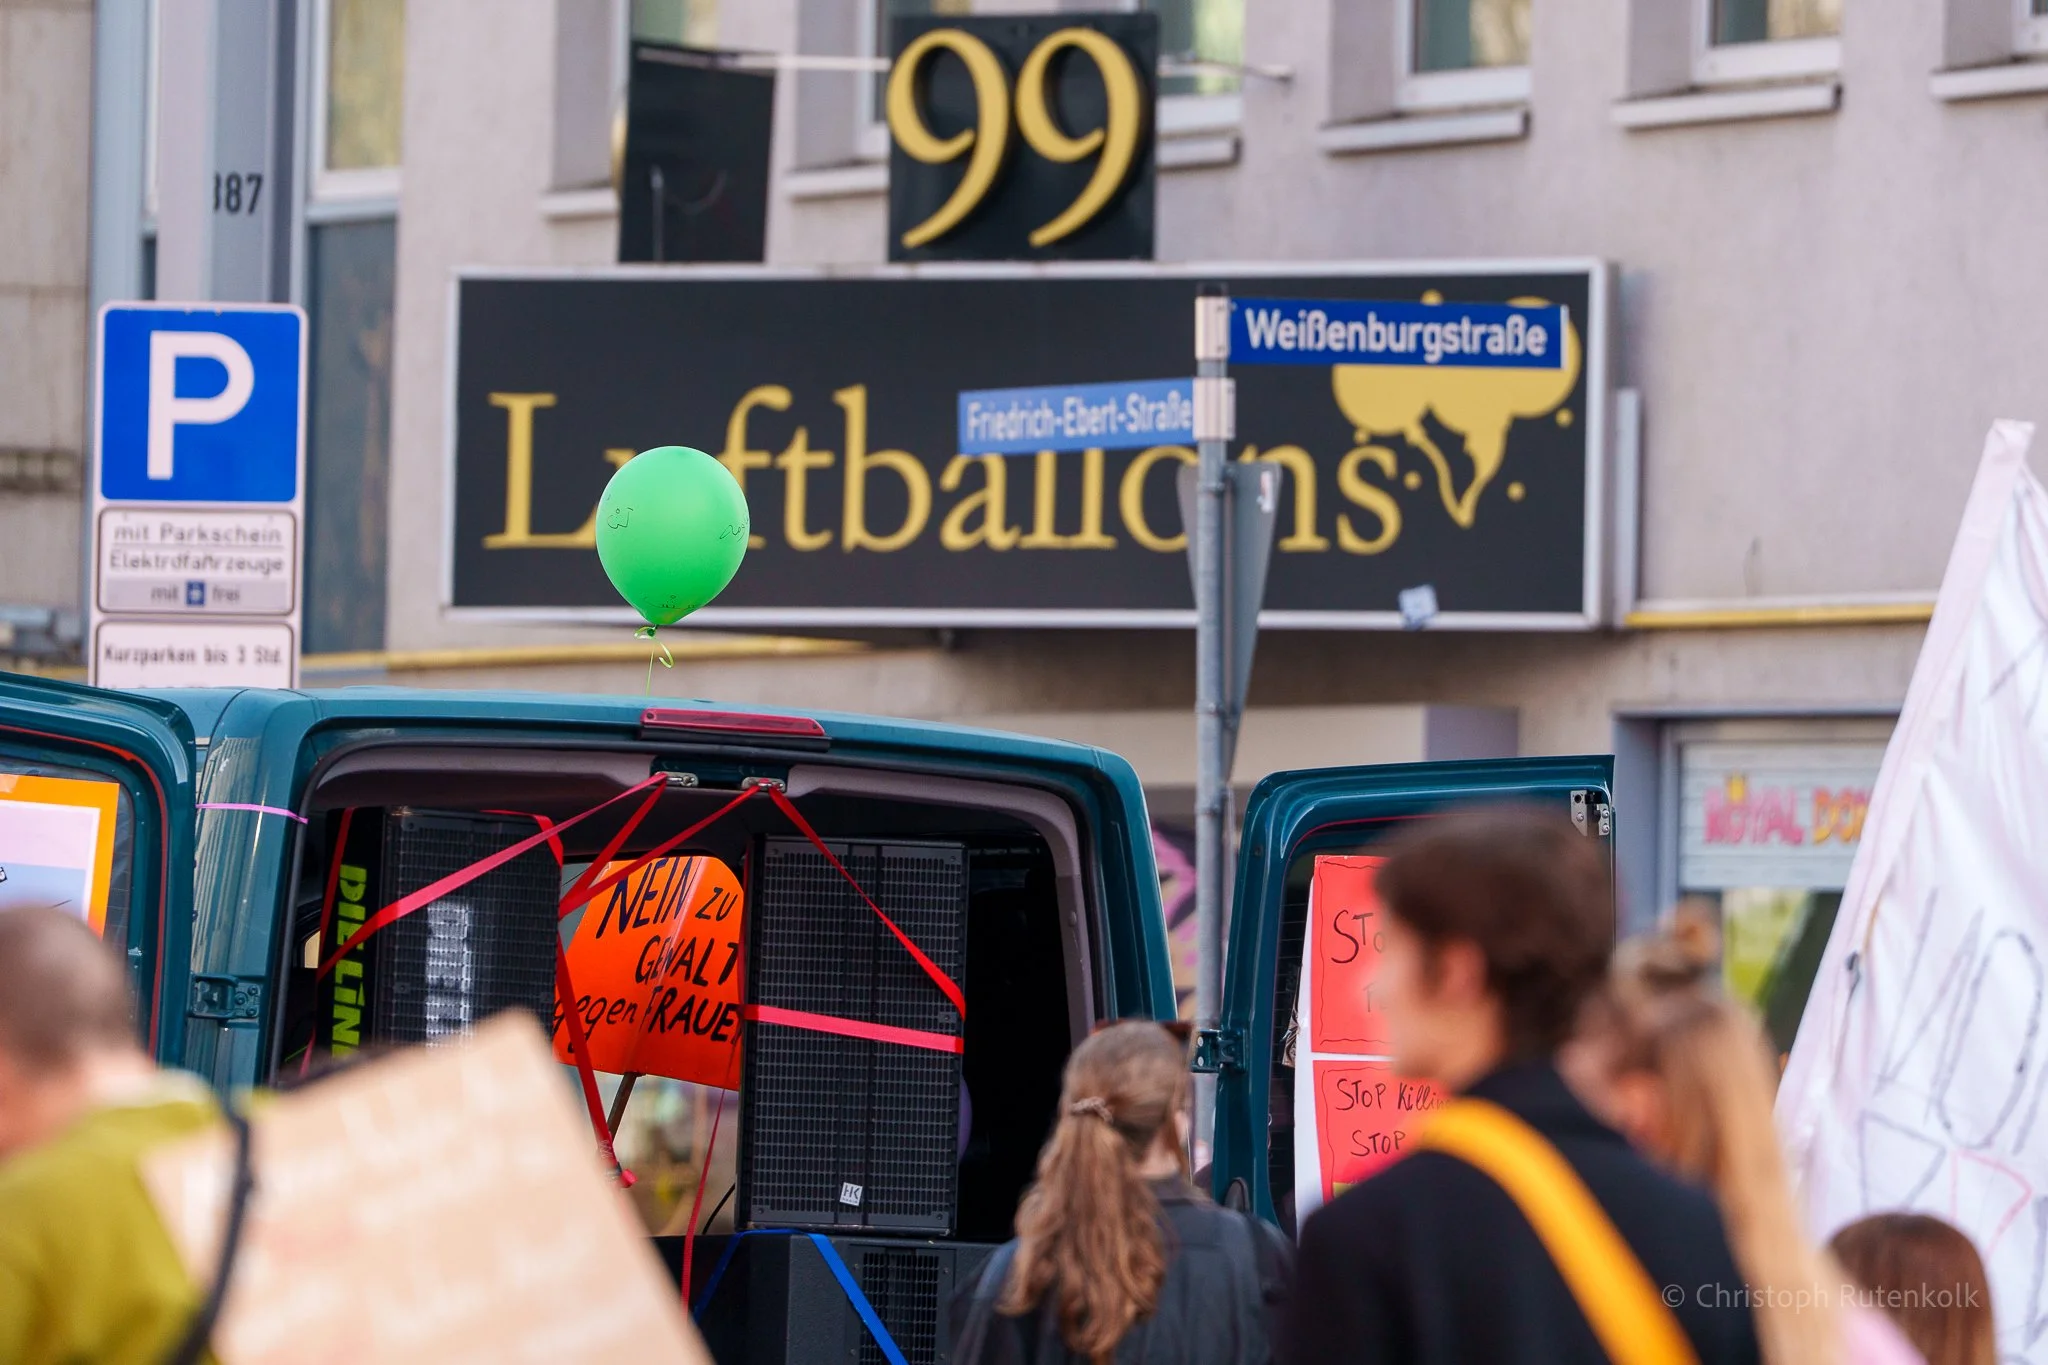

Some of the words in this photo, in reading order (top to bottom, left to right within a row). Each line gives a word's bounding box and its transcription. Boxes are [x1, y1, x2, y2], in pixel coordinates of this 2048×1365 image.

[886, 28, 1140, 248] 99
[1245, 307, 1548, 363] Weißenburgstraße
[147, 330, 254, 481] P
[966, 390, 1192, 442] Friedrich-Ebert-Straße
[113, 524, 150, 542] mit
[160, 522, 283, 543] Parkschein
[109, 551, 285, 576] Elektrofahrzeuge
[151, 586, 180, 601] mit
[211, 586, 242, 601] frei
[103, 644, 197, 669] Kurzparken
[203, 647, 228, 665] bis
[336, 864, 367, 950] DIE
[595, 857, 689, 940] NEIN
[635, 935, 740, 987] GEWALT
[1331, 909, 1386, 964] STO
[1336, 1078, 1387, 1111] STOP
[1398, 1082, 1450, 1111] Killin
[1351, 1129, 1406, 1157] STOP
[843, 1184, 861, 1200] HK
